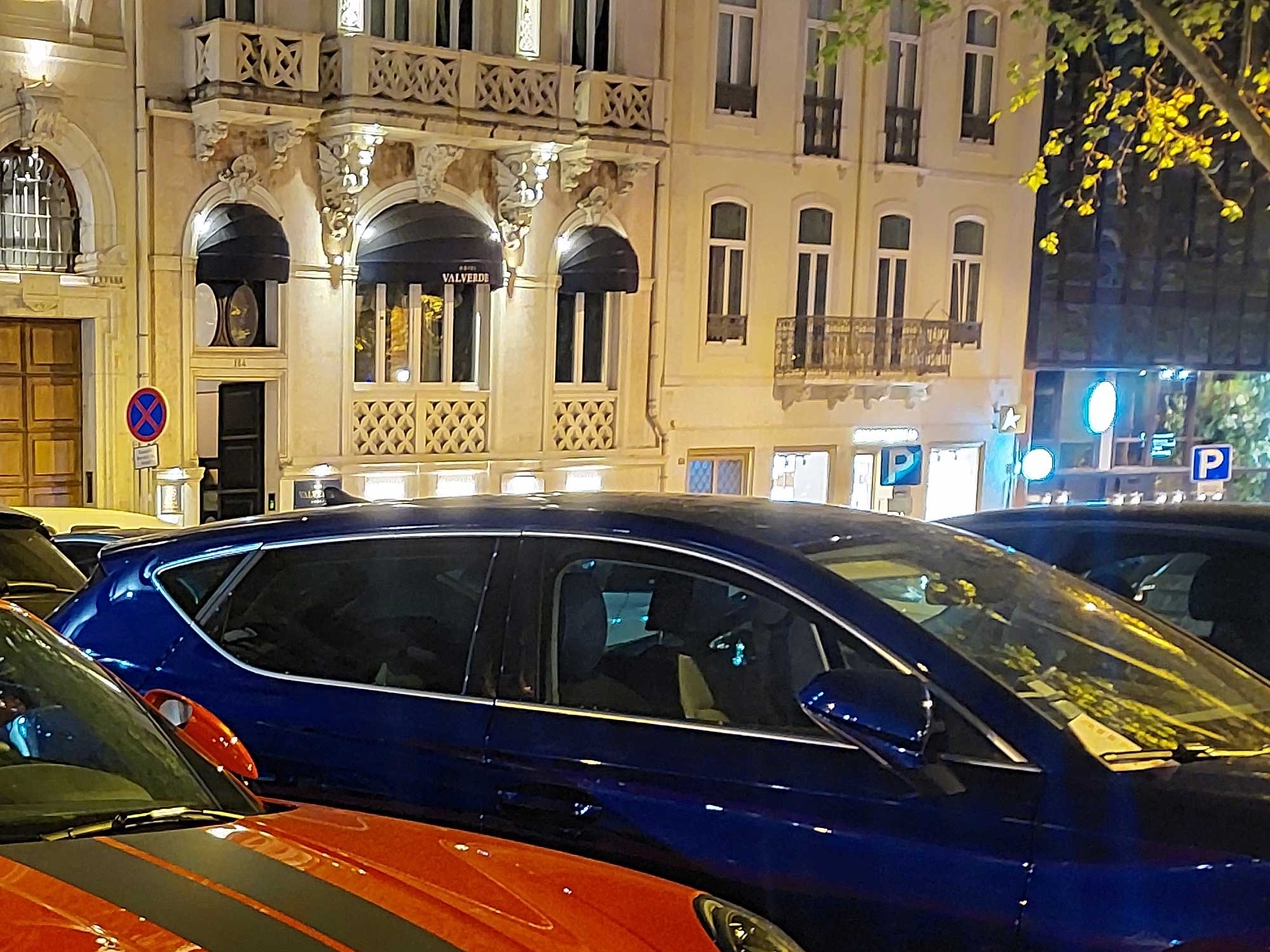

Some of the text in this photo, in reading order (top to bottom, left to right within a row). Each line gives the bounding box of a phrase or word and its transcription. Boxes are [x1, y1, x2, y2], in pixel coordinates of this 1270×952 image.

[442, 272, 490, 283] VALVERDE
[887, 446, 915, 485] P
[1199, 448, 1224, 479] P
